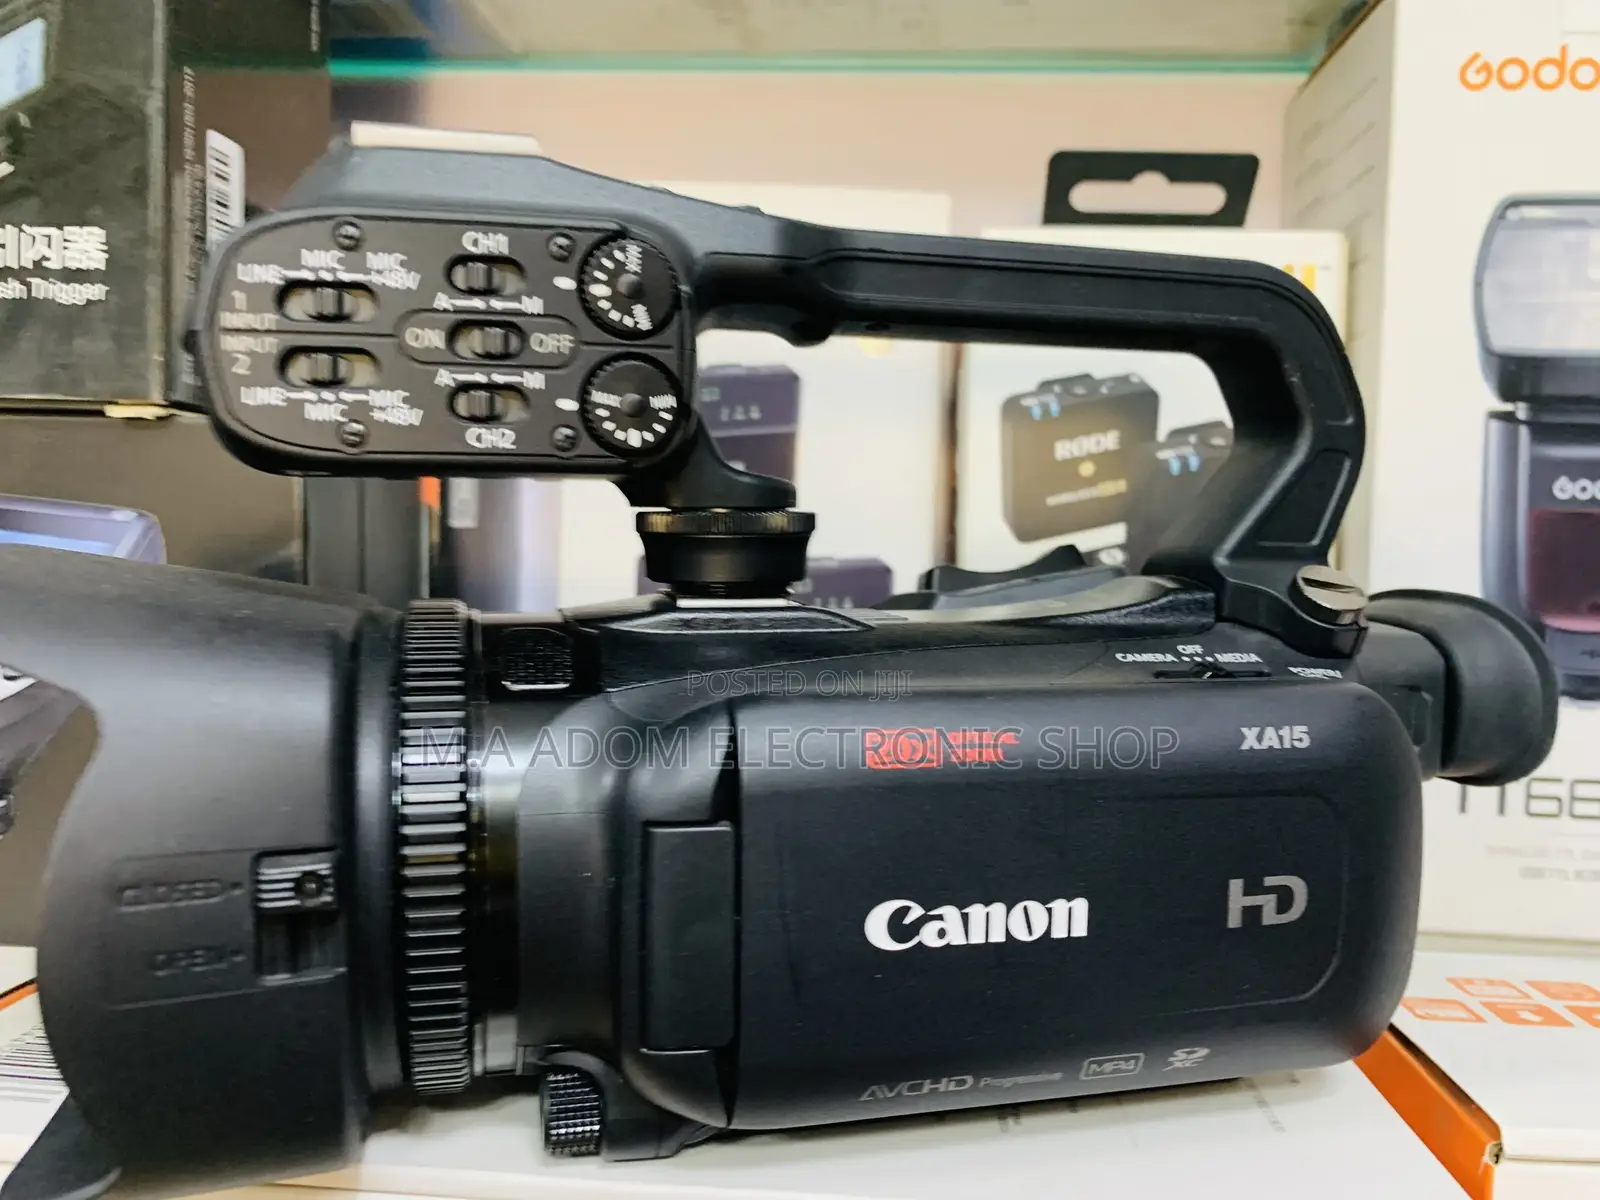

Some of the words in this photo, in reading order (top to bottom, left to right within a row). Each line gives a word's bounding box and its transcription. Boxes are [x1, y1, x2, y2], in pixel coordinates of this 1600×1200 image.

[1459, 44, 1600, 91] Godo
[461, 231, 509, 255] CH1
[300, 248, 345, 270] MIC
[366, 252, 407, 271] MIC
[26, 277, 110, 305] Trigger
[404, 327, 446, 350] ON
[530, 332, 576, 355] OFF
[231, 353, 251, 375] 2
[369, 389, 410, 409] MIC
[304, 402, 348, 422] MIC
[465, 427, 516, 449] CH2
[1115, 653, 1179, 663] CAMERA
[1214, 652, 1263, 663] MEDIA
[1177, 644, 1204, 655] OFF
[1239, 725, 1311, 751] XA15
[1226, 875, 1309, 929] HD
[864, 897, 1089, 952] Canon
[1087, 1059, 1136, 1075] MP4
[859, 1075, 975, 1101] AVCHD
